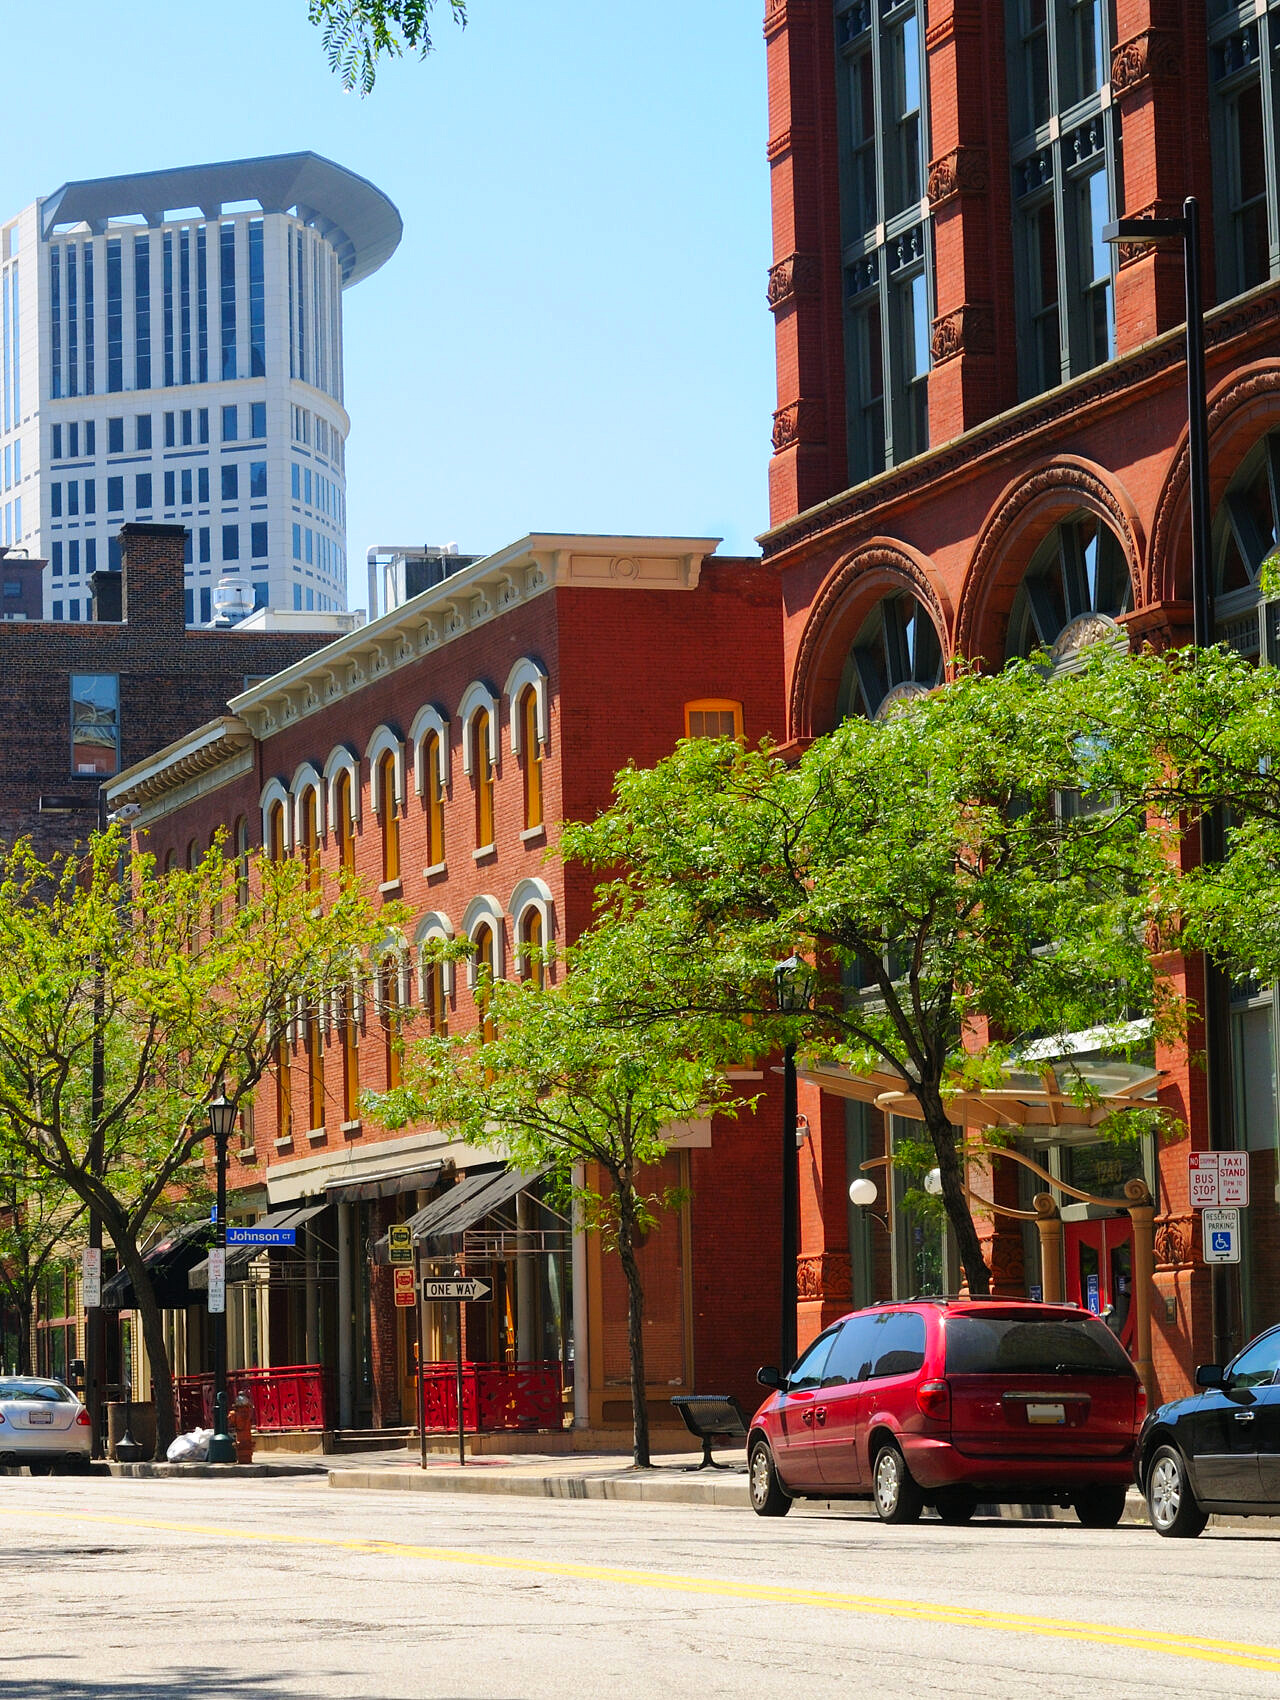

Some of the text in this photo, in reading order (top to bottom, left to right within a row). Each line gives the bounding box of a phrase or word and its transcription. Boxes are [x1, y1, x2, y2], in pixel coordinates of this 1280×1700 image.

[1223, 1158, 1242, 1166] TAXI
[1219, 1169, 1246, 1177] STAND
[1195, 1174, 1214, 1184] BUS
[1193, 1185, 1216, 1195] STOP
[1208, 1222, 1235, 1230] PARKING
[230, 1230, 279, 1241] Johnson
[430, 1283, 452, 1296] ONE
[456, 1283, 477, 1296] WAY
